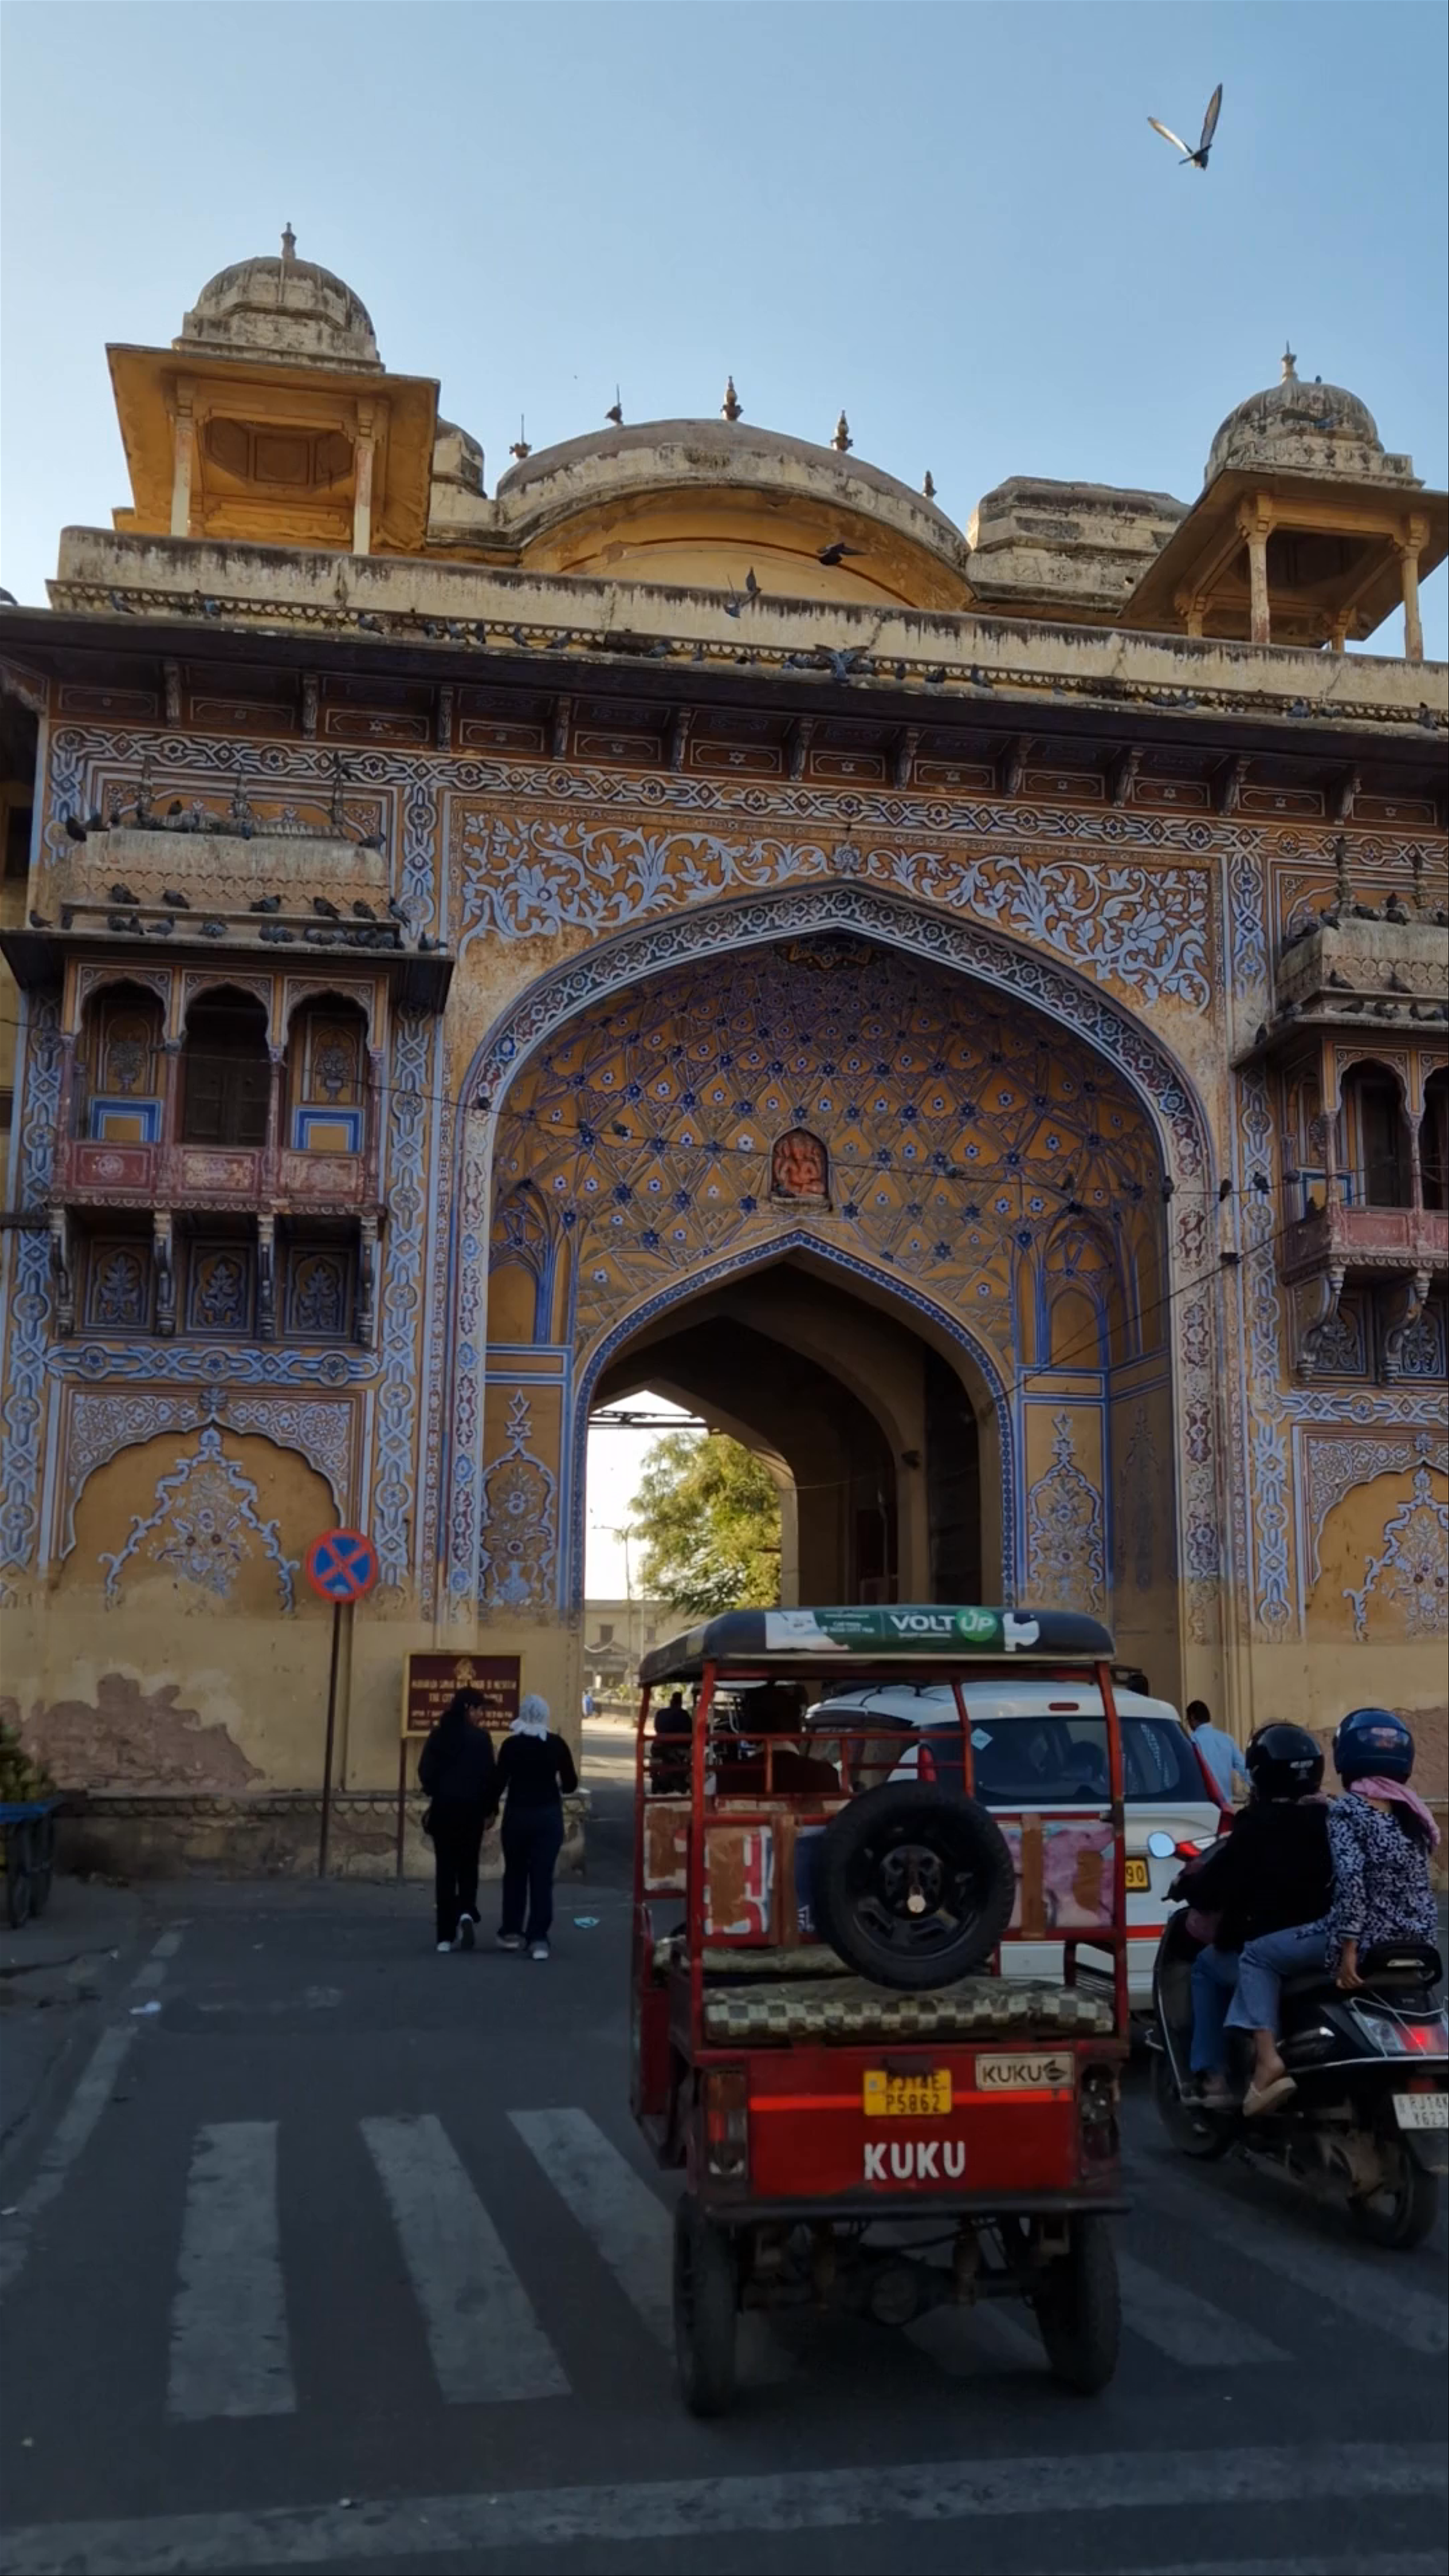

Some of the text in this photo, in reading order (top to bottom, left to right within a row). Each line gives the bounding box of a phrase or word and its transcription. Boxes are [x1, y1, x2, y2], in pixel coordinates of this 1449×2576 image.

[890, 1608, 994, 1632] VOLT UP
[982, 2064, 1042, 2082] KUKU
[863, 2140, 966, 2180] KUKU
